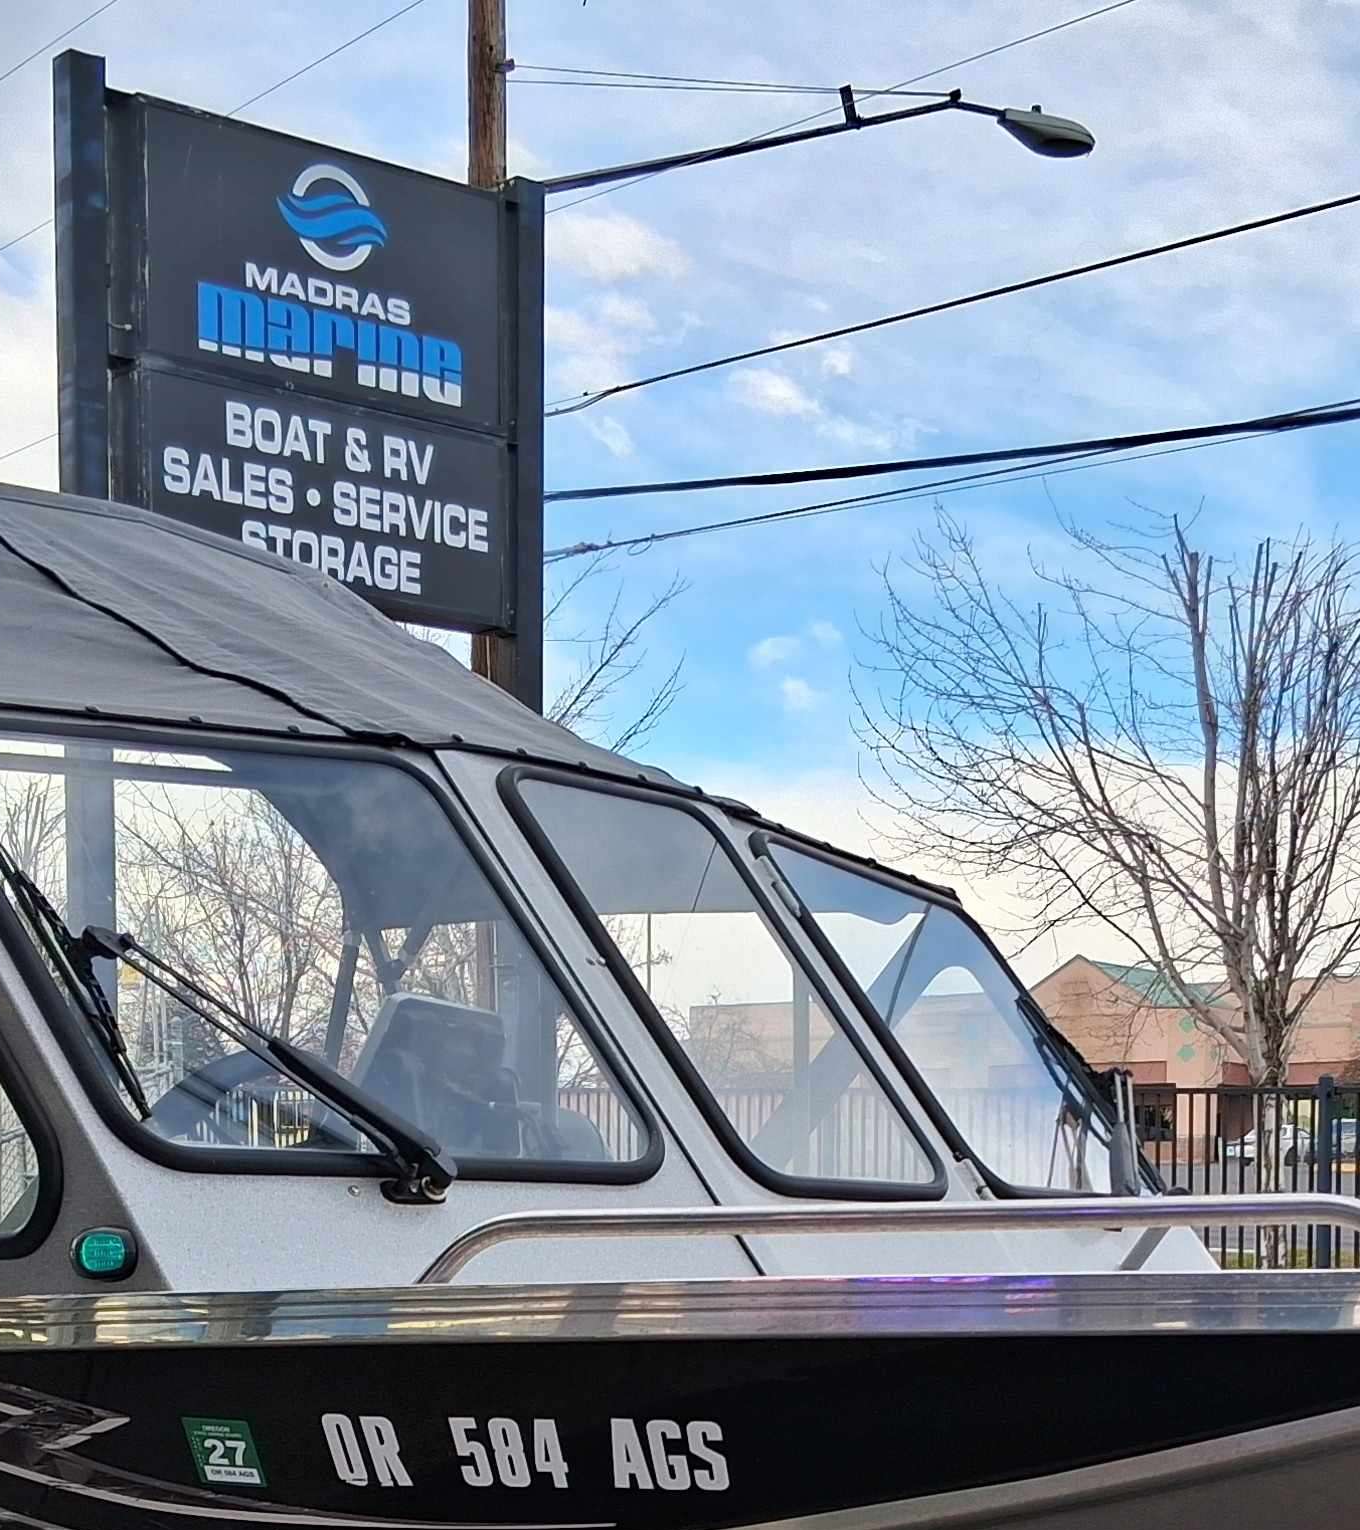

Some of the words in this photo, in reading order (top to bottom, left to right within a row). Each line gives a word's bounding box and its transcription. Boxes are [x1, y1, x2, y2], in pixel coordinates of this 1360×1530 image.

[245, 262, 411, 326] MADRAS
[225, 401, 331, 463] BOAT
[345, 428, 370, 471] &
[383, 436, 434, 484] RV
[163, 447, 294, 513] SALES
[333, 481, 489, 553] SERVICE
[203, 1439, 246, 1466] 27
[322, 1413, 414, 1487] OR
[448, 1417, 569, 1488] 584
[611, 1418, 730, 1491] AGS
